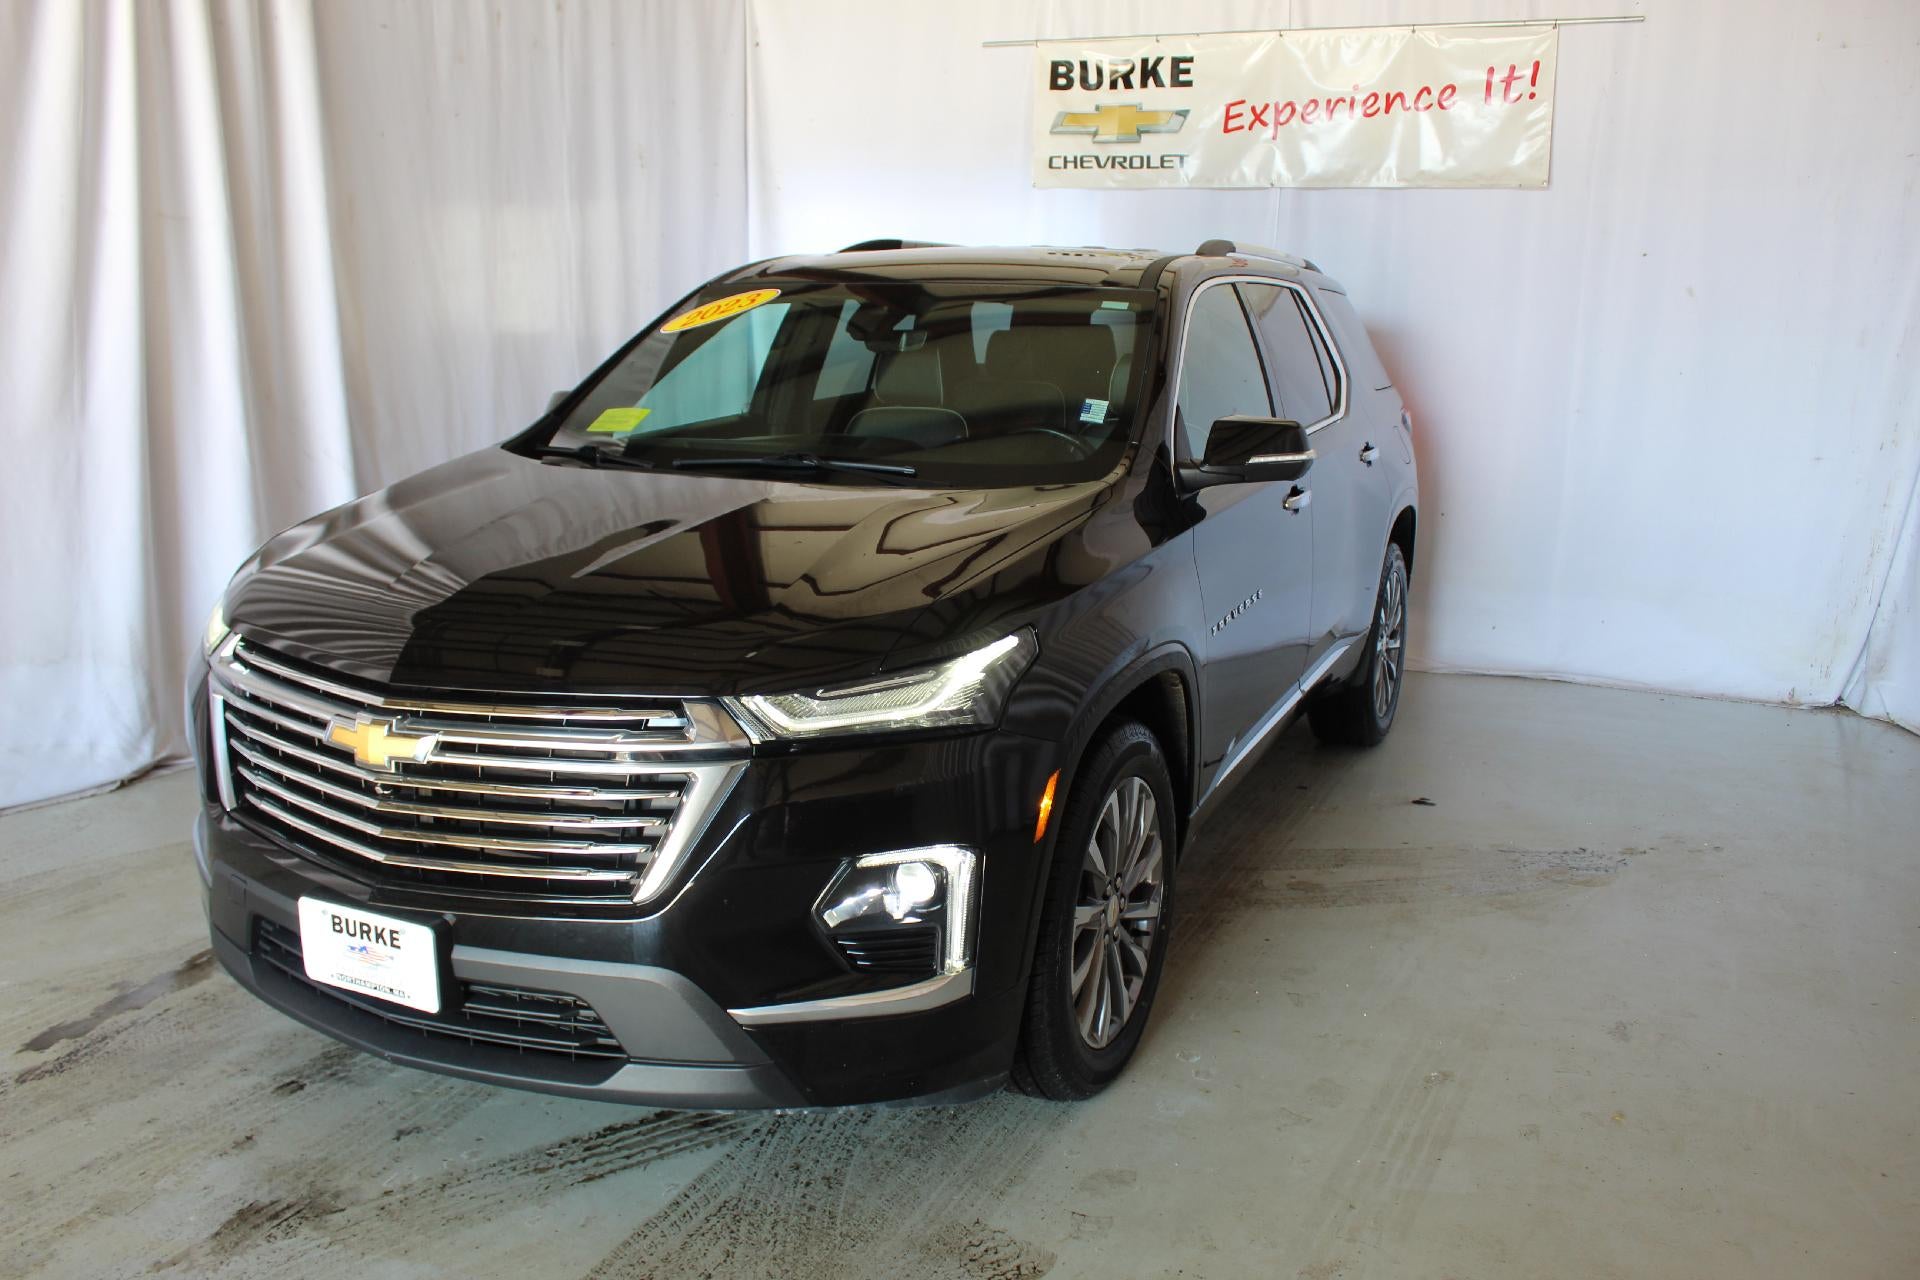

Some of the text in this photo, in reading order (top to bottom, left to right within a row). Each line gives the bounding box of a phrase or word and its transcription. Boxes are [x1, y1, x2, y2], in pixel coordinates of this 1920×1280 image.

[1049, 56, 1194, 91] BURKE
[1222, 60, 1541, 141] Experience It!
[1048, 154, 1190, 170] CHEVROLET
[680, 292, 762, 328] 2023
[331, 914, 401, 950] BURKE
